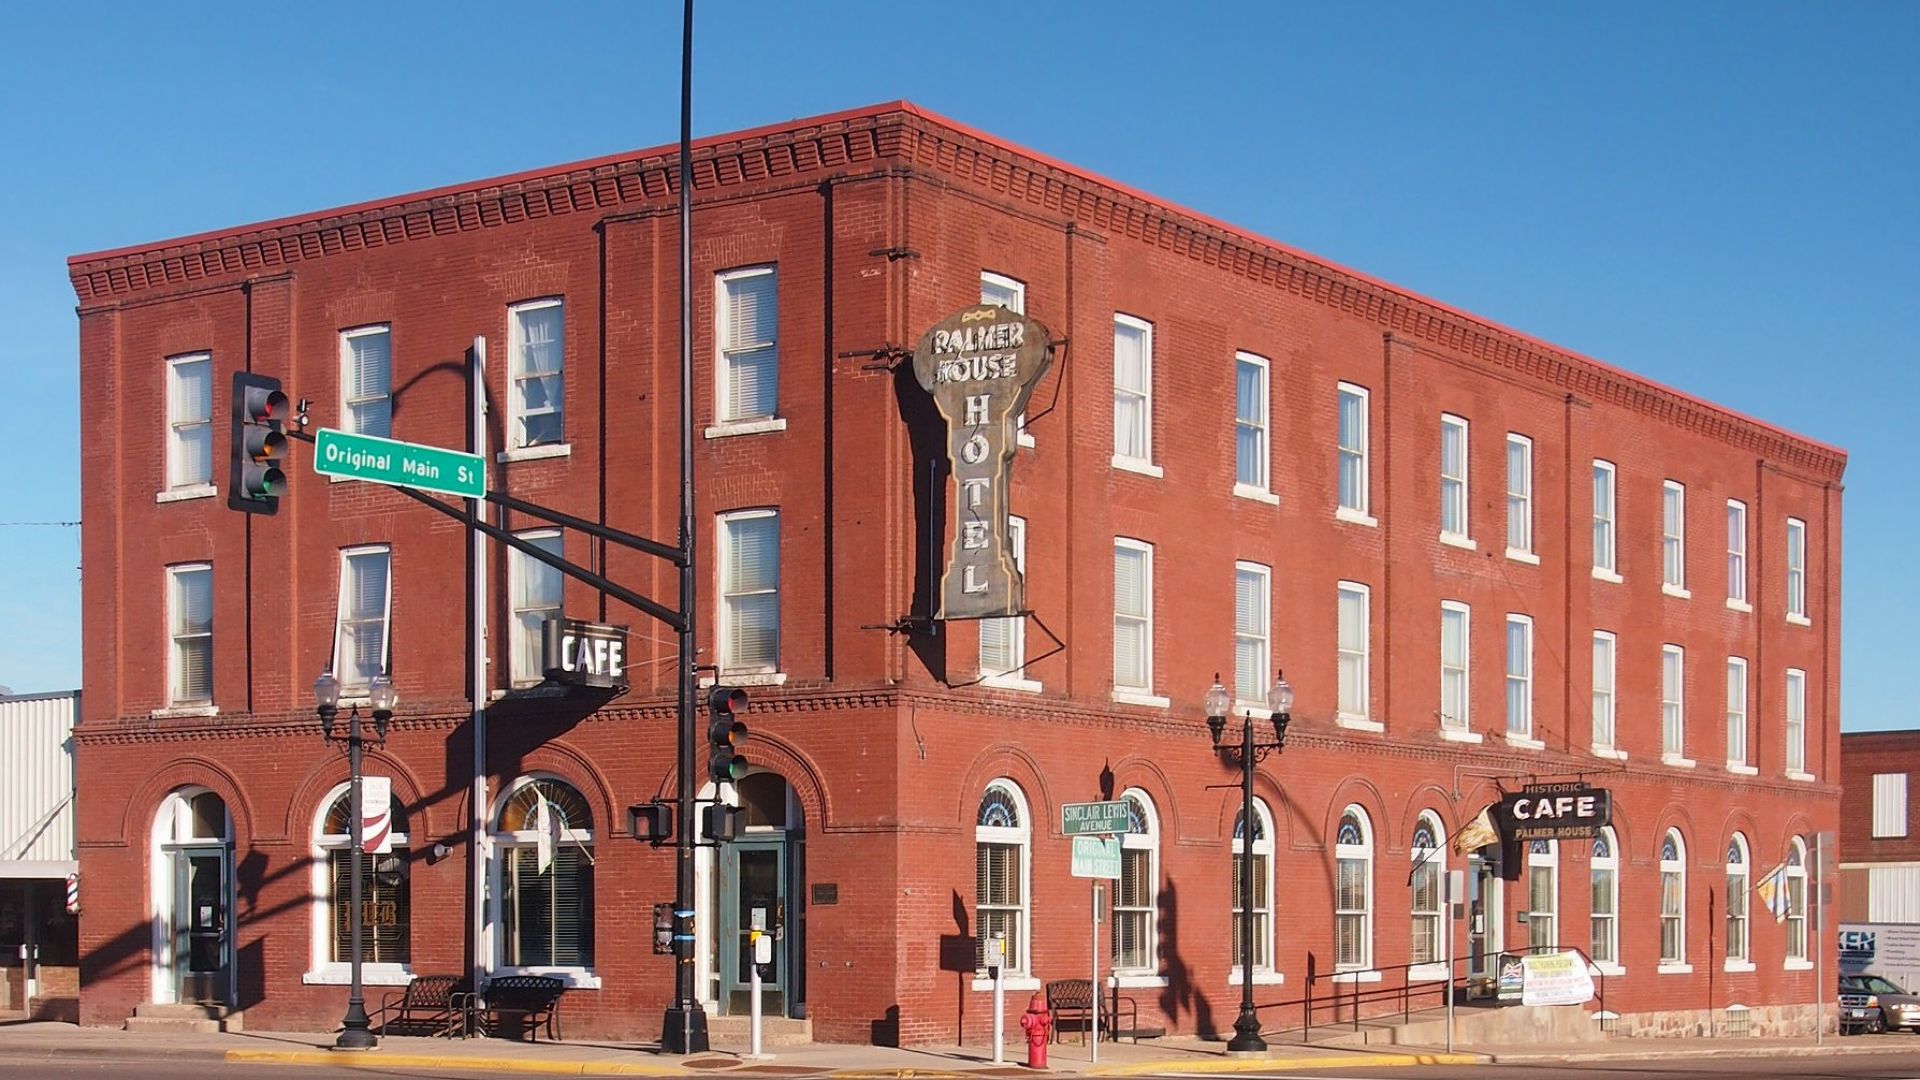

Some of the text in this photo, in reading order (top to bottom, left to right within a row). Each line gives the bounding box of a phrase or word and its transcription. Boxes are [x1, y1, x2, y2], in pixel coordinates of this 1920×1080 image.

[932, 322, 1023, 354] PALMER
[934, 354, 1017, 383] HOUSE
[326, 444, 474, 484] Original Main St
[961, 393, 991, 594] HOTEL
[562, 636, 622, 676] CAFE
[1526, 784, 1581, 793] HISTORIC
[1065, 803, 1127, 821] SINCLAIR LEWIS
[1513, 797, 1596, 820] CAFE
[1080, 820, 1112, 831] AVENUE
[1515, 826, 1592, 838] PALMER HOUSE
[1077, 840, 1116, 857] ORIGINAL
